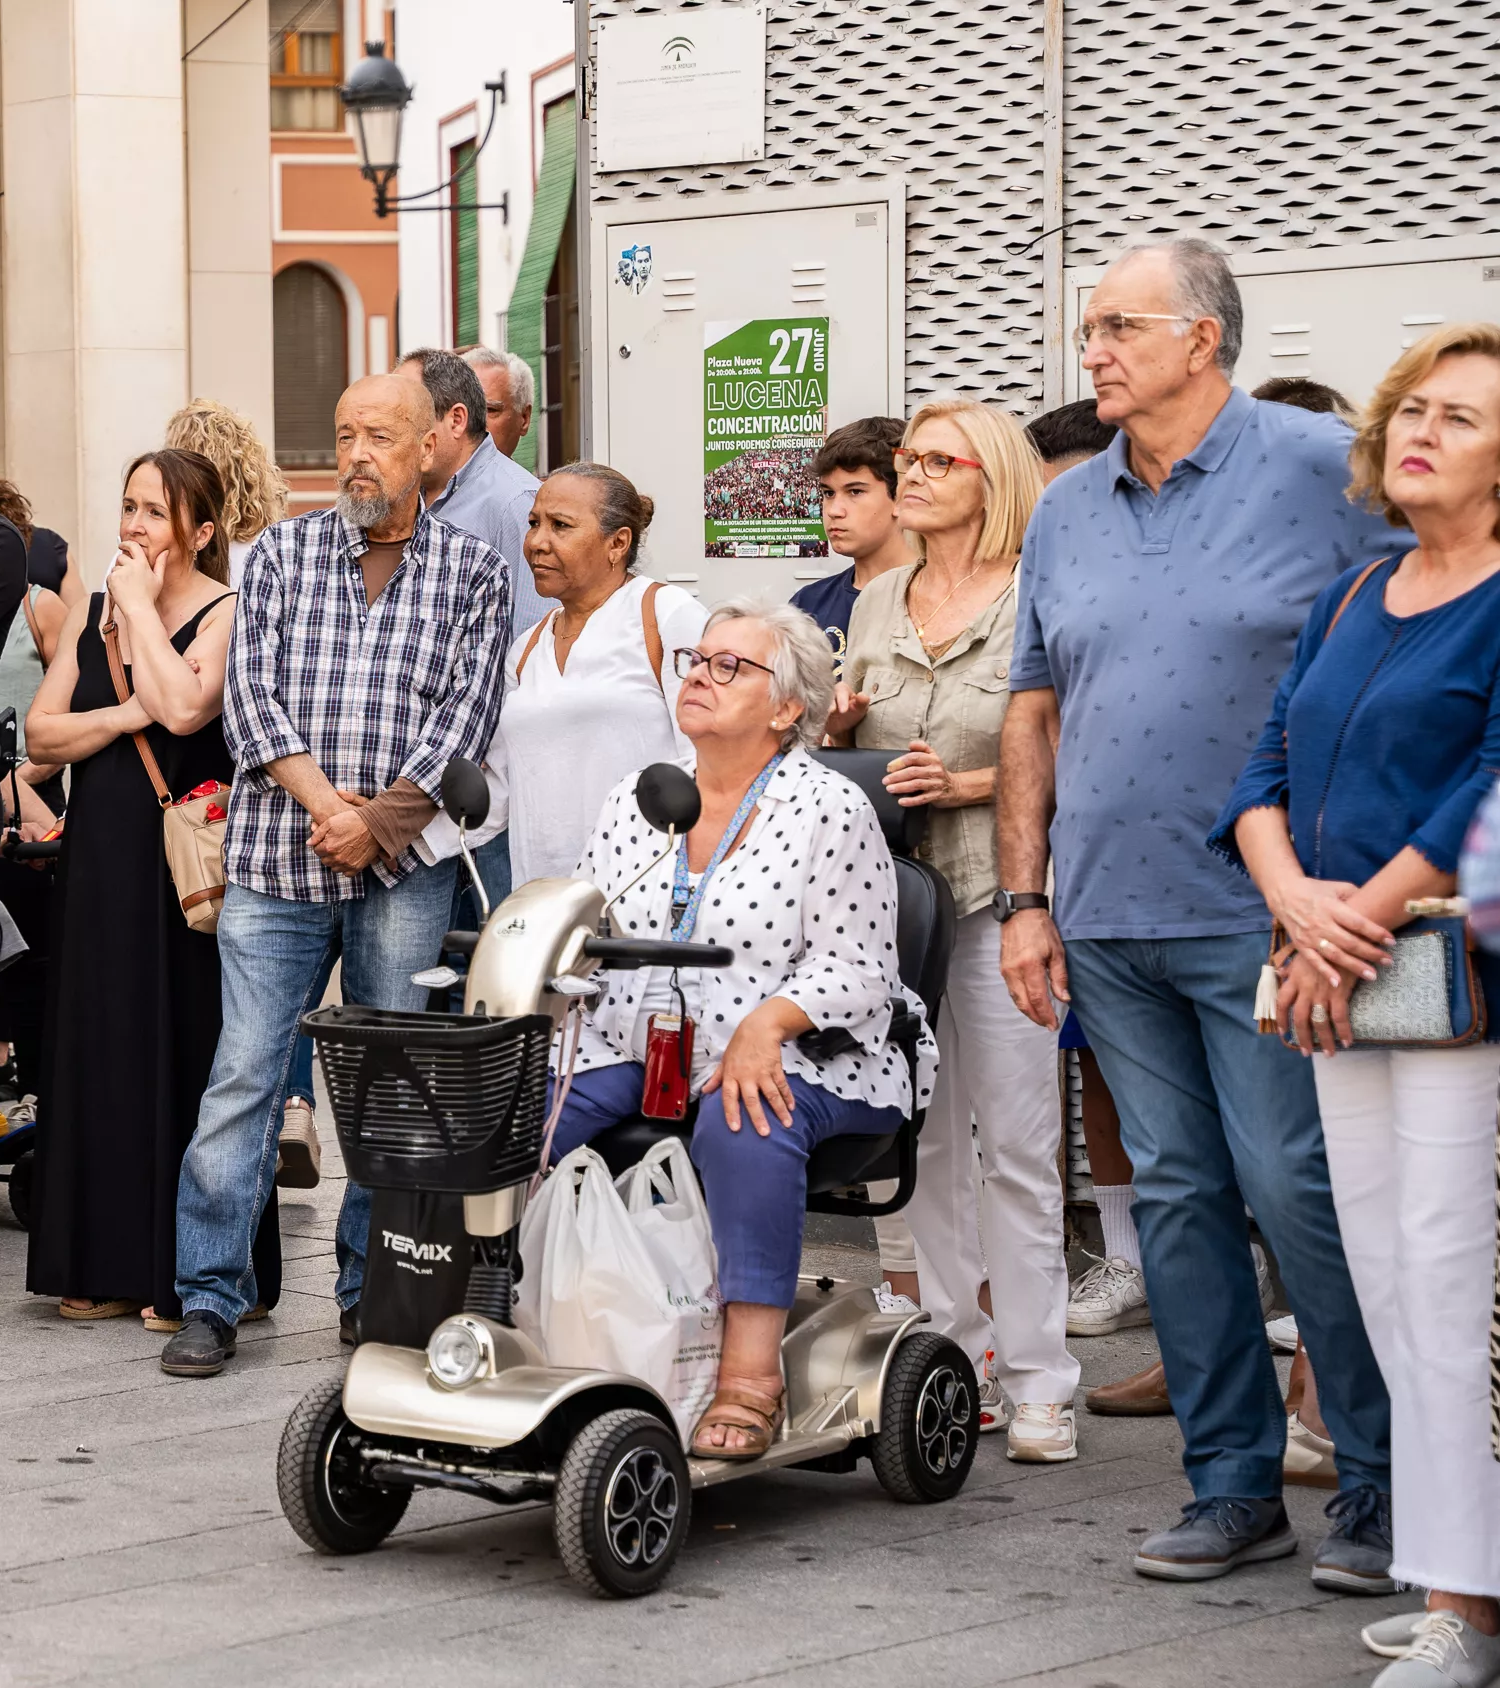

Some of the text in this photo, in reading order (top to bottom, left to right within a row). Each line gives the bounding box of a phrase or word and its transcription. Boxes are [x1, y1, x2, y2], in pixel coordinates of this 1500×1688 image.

[708, 356, 762, 368] Plaza Nueva
[769, 328, 813, 375] 27
[814, 328, 824, 372] JUNIO
[708, 378, 824, 411] LUCENA
[708, 410, 822, 435] CONCENTRACIÓN
[705, 437, 823, 451] JUNTOS PODEMOS CONSEGUIRLO
[382, 1230, 453, 1262] TERMIX
